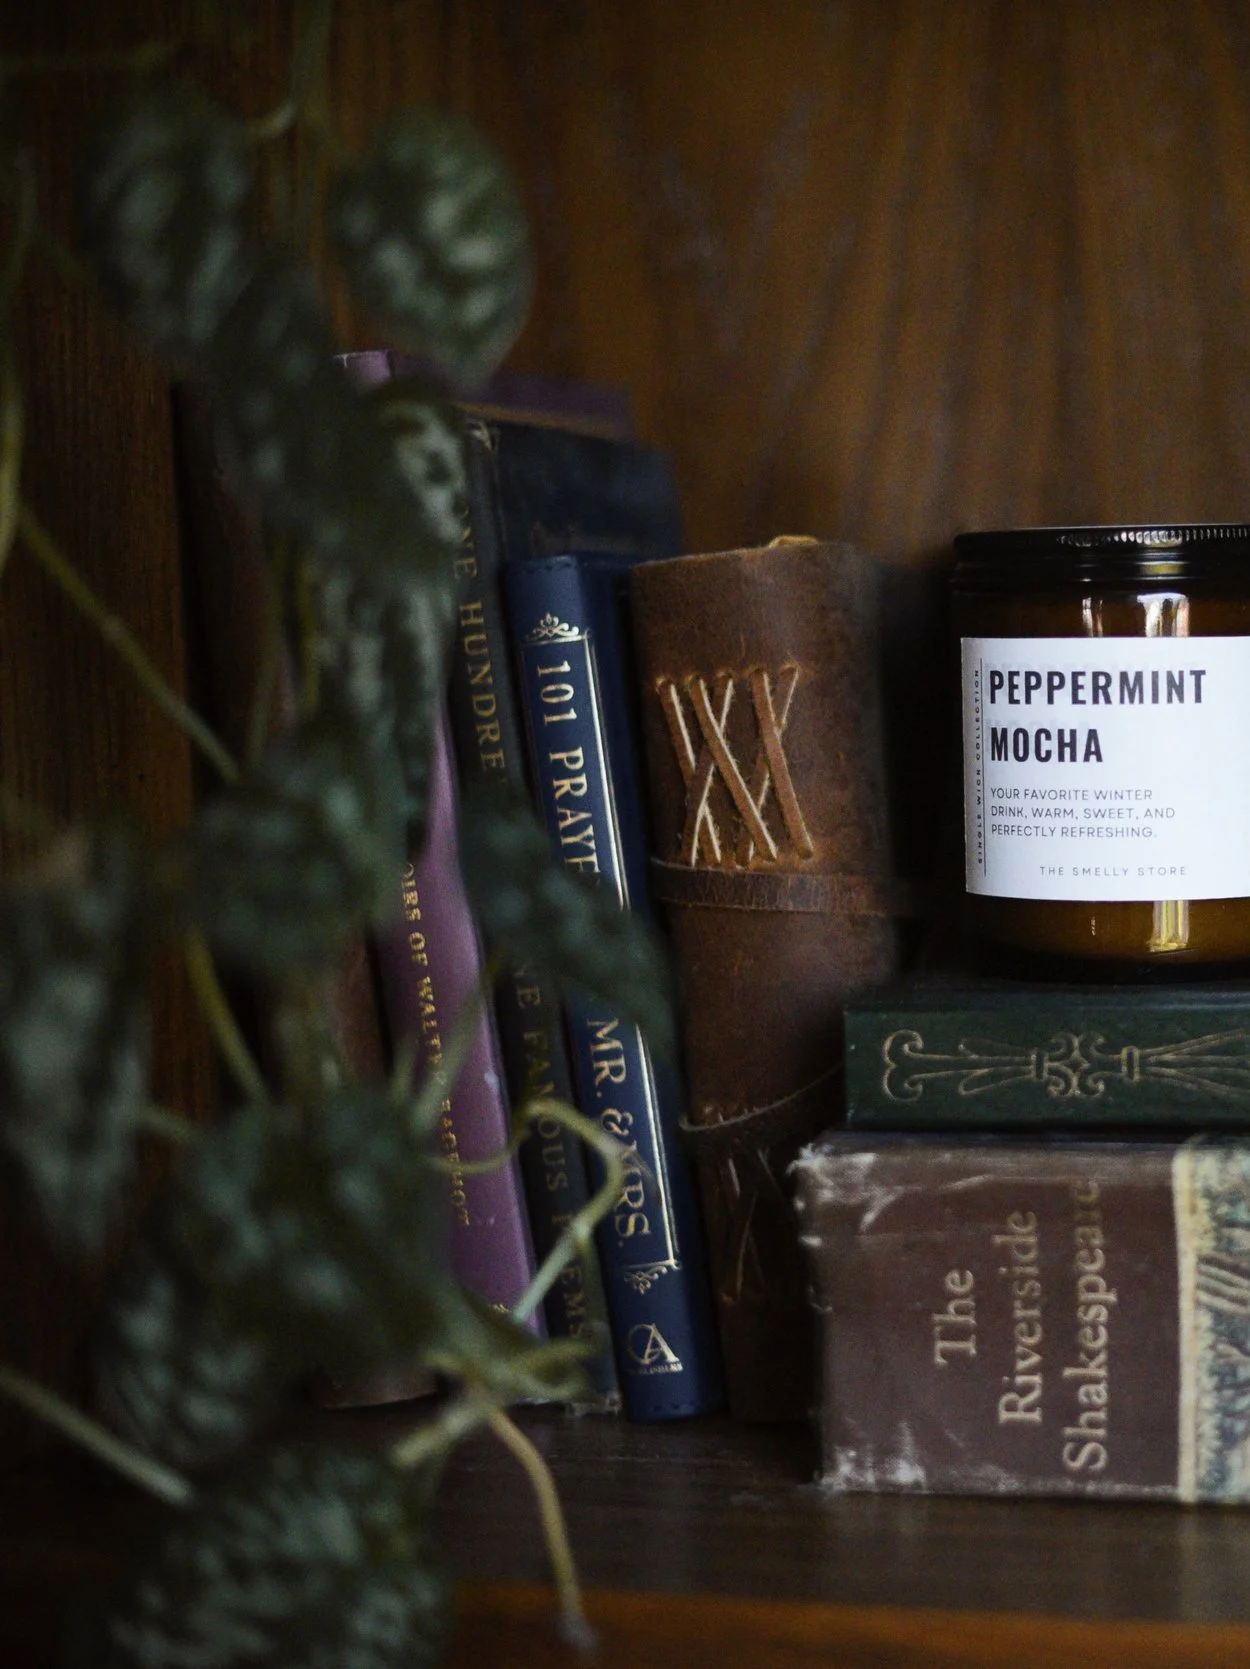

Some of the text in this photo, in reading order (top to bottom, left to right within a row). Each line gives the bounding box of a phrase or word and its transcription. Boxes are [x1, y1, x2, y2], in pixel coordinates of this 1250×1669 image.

[536, 659, 578, 726] 101
[989, 669, 1207, 706] PEPPERMINT
[990, 726, 1104, 763] MOCHA
[548, 744, 602, 880] PRAYE
[990, 787, 1153, 801] YOUR FAVORITE WINTER
[991, 805, 1176, 820] DRINK, WARM, SWEET, AND
[991, 824, 1158, 838] PERFECTLY REFRESHING.
[1039, 866, 1187, 877] THE SMELLY STORE
[408, 930, 429, 967] OF
[459, 599, 507, 778] HUNDRE
[551, 1213, 585, 1339] PEMS
[586, 1017, 627, 1098] MR.
[931, 1267, 977, 1367] The
[991, 1209, 1043, 1425] Riverside
